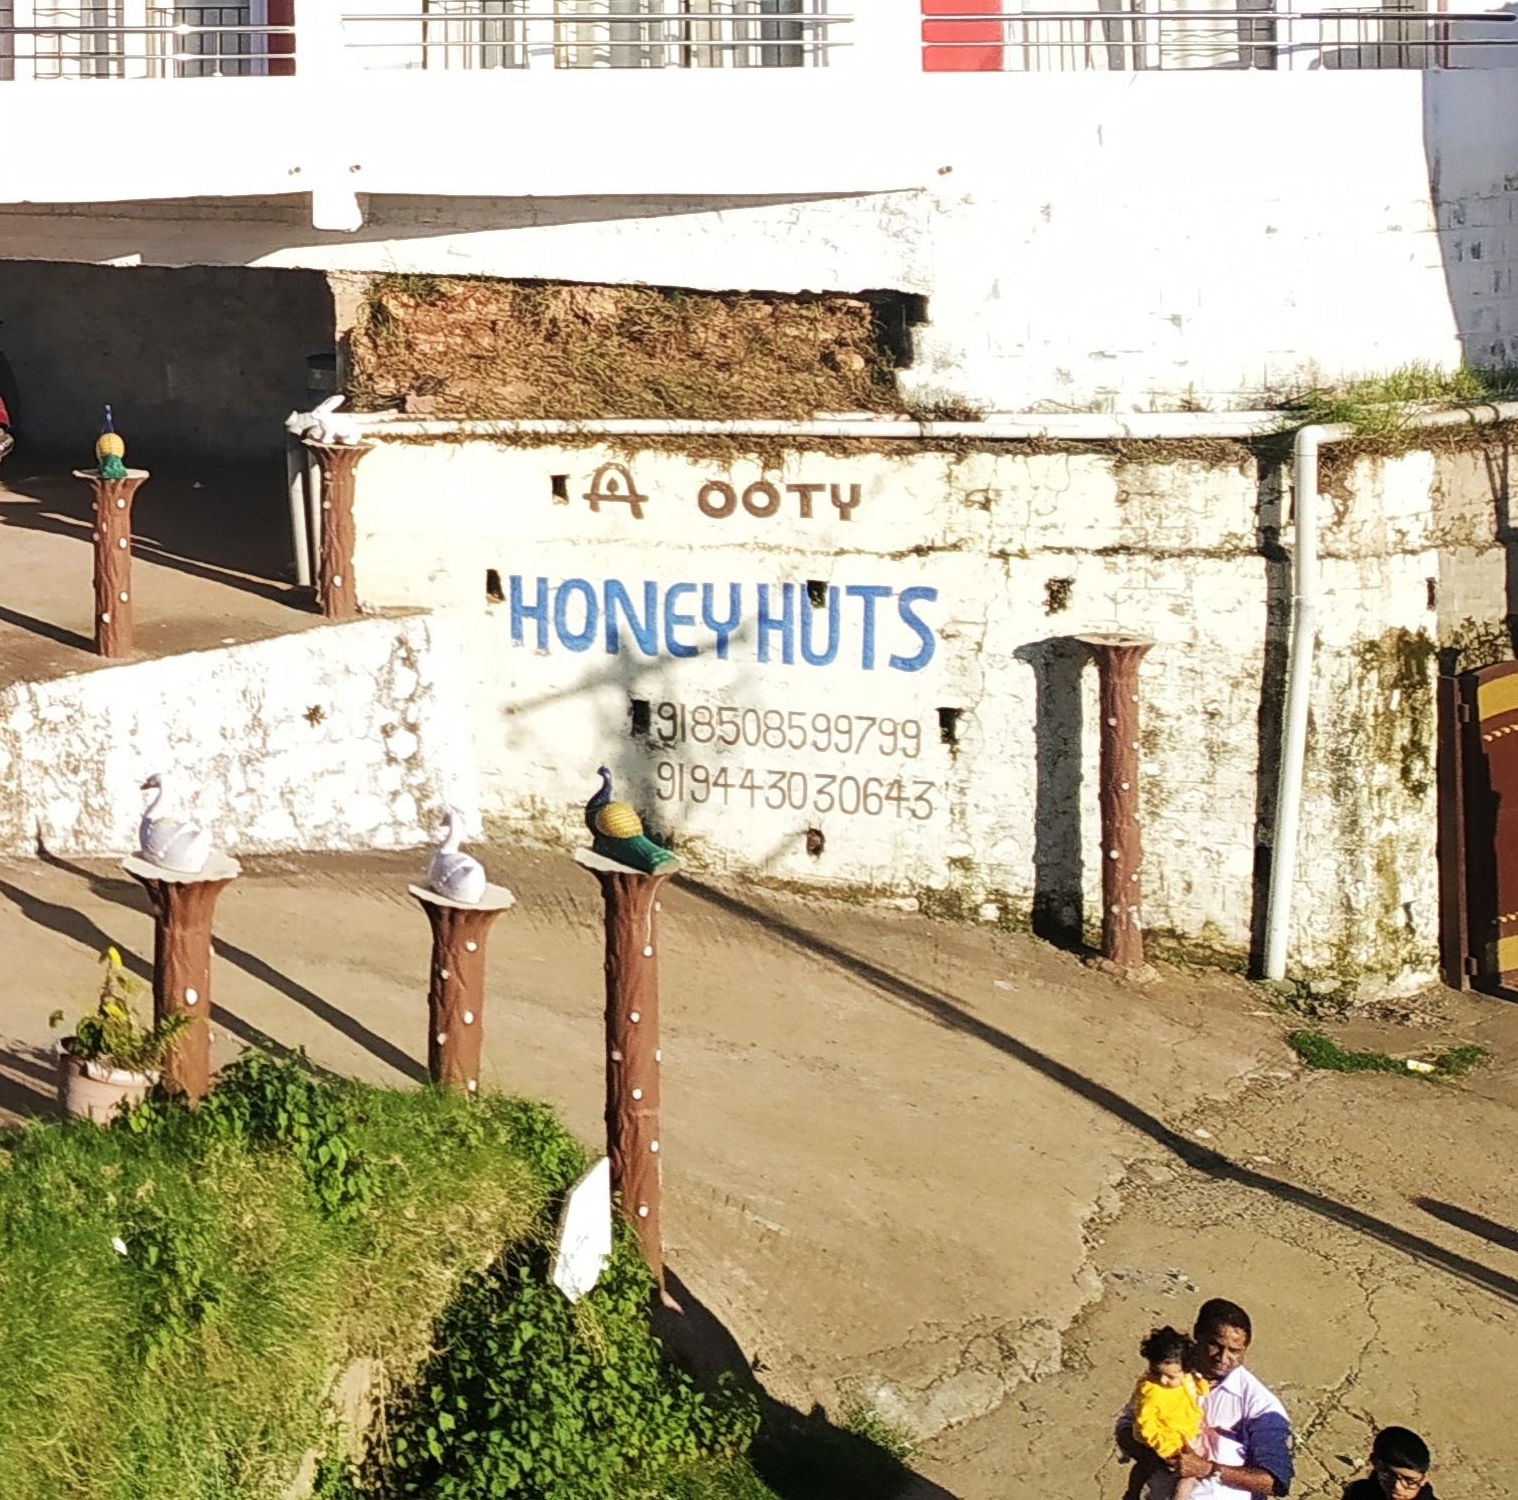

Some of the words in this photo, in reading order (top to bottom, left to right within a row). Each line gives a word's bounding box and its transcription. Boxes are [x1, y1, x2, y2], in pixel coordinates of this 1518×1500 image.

[697, 479, 862, 521] OOTY
[508, 574, 742, 660] HONEY
[756, 581, 939, 673] HUTS
[656, 701, 922, 759] 918508599799
